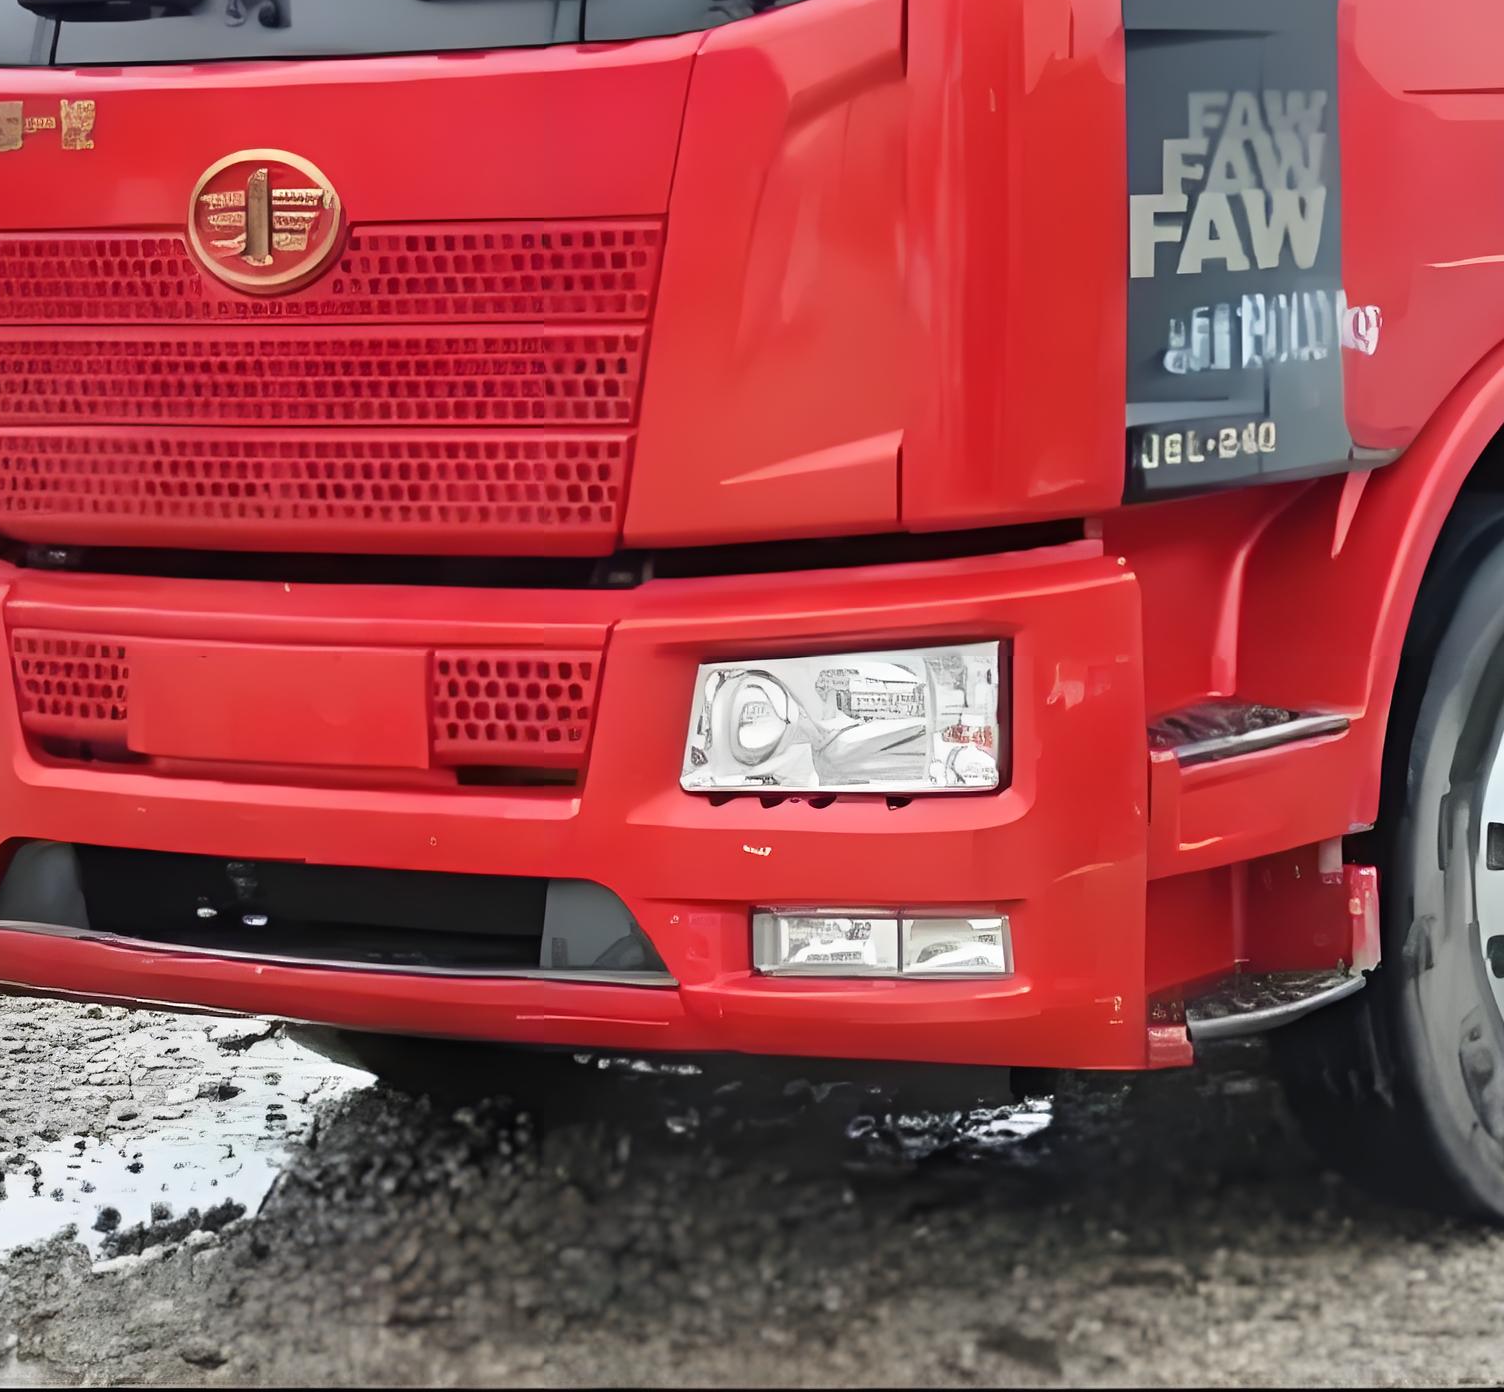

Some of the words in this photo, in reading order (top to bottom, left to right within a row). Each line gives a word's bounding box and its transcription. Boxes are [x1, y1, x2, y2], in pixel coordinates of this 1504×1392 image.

[1188, 89, 1327, 144] FAW
[1163, 134, 1327, 194] FAW
[1130, 186, 1326, 279] FAW
